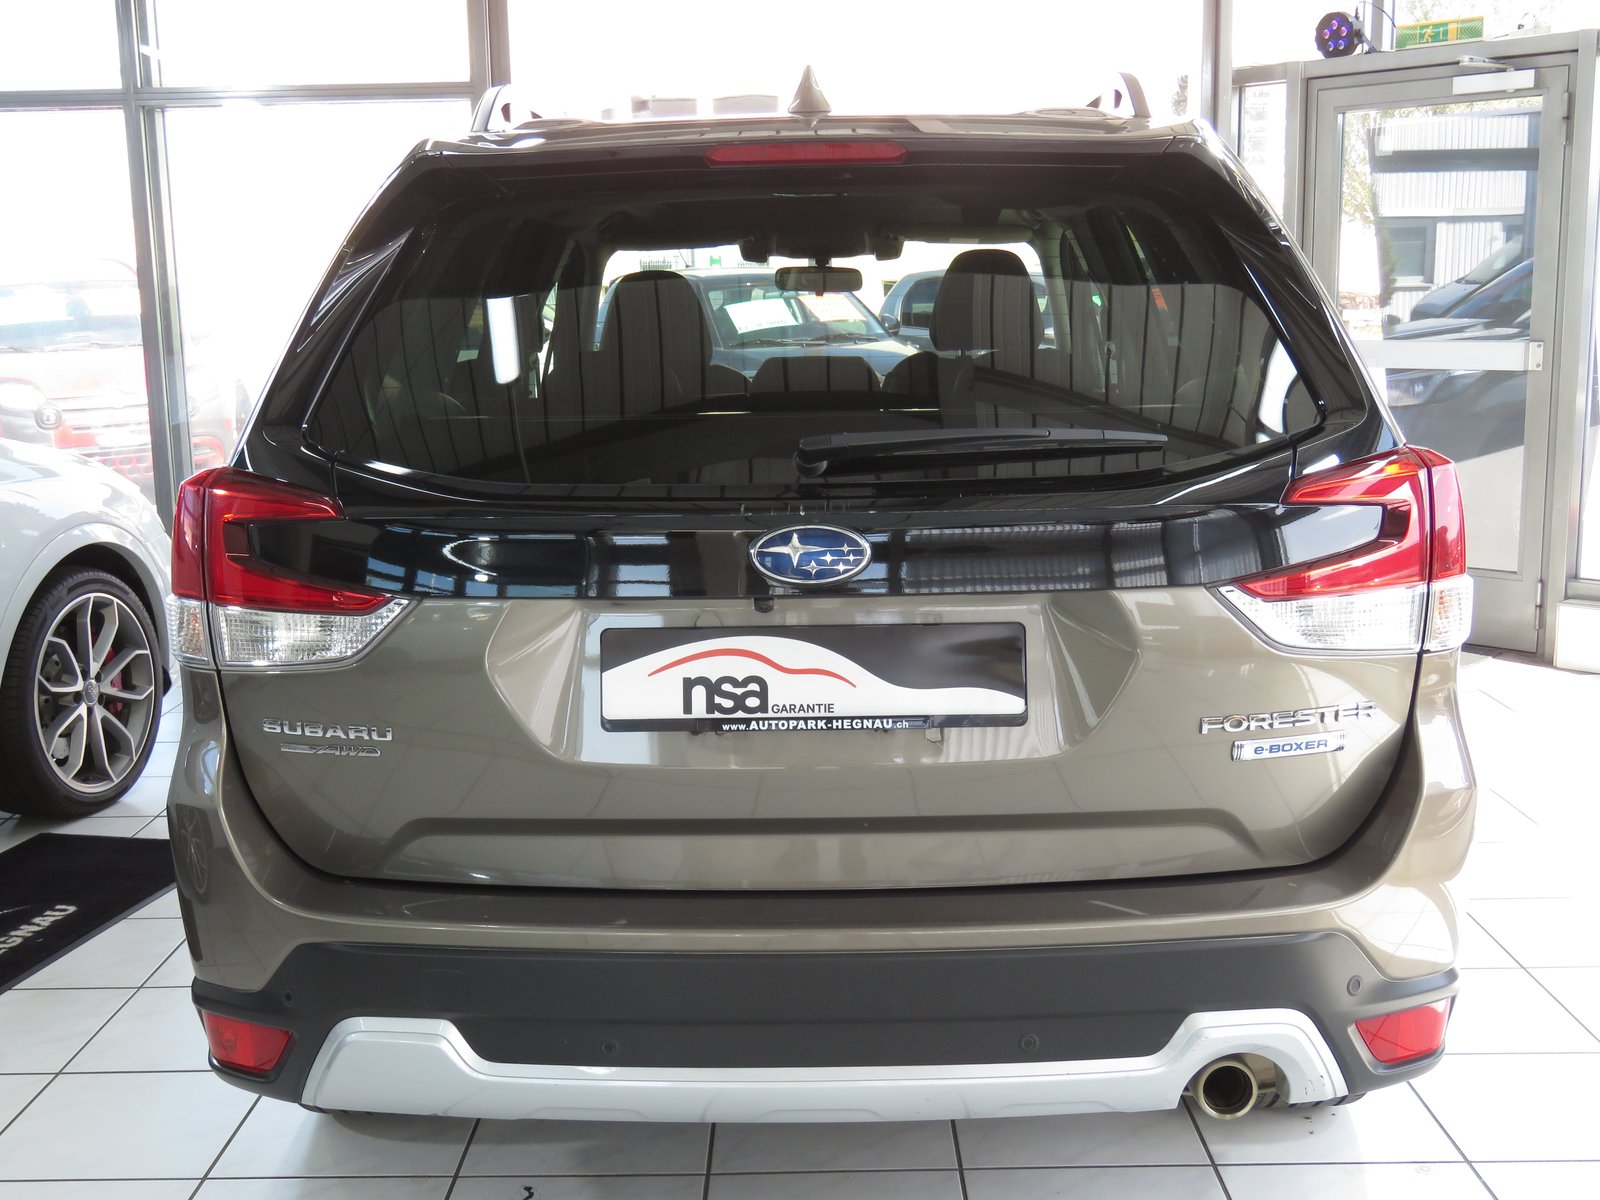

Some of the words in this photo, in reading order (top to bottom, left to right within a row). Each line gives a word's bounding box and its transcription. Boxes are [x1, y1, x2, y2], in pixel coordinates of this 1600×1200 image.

[682, 675, 769, 716] nsa
[771, 703, 835, 714] GARANTIE
[262, 718, 393, 741] SUBARU
[722, 719, 909, 731] www.AUTOPARK-HEGNAU.ch
[1199, 701, 1377, 735] FORESTER
[1254, 739, 1328, 755] e-BOXER
[0, 904, 78, 955] GNAU
